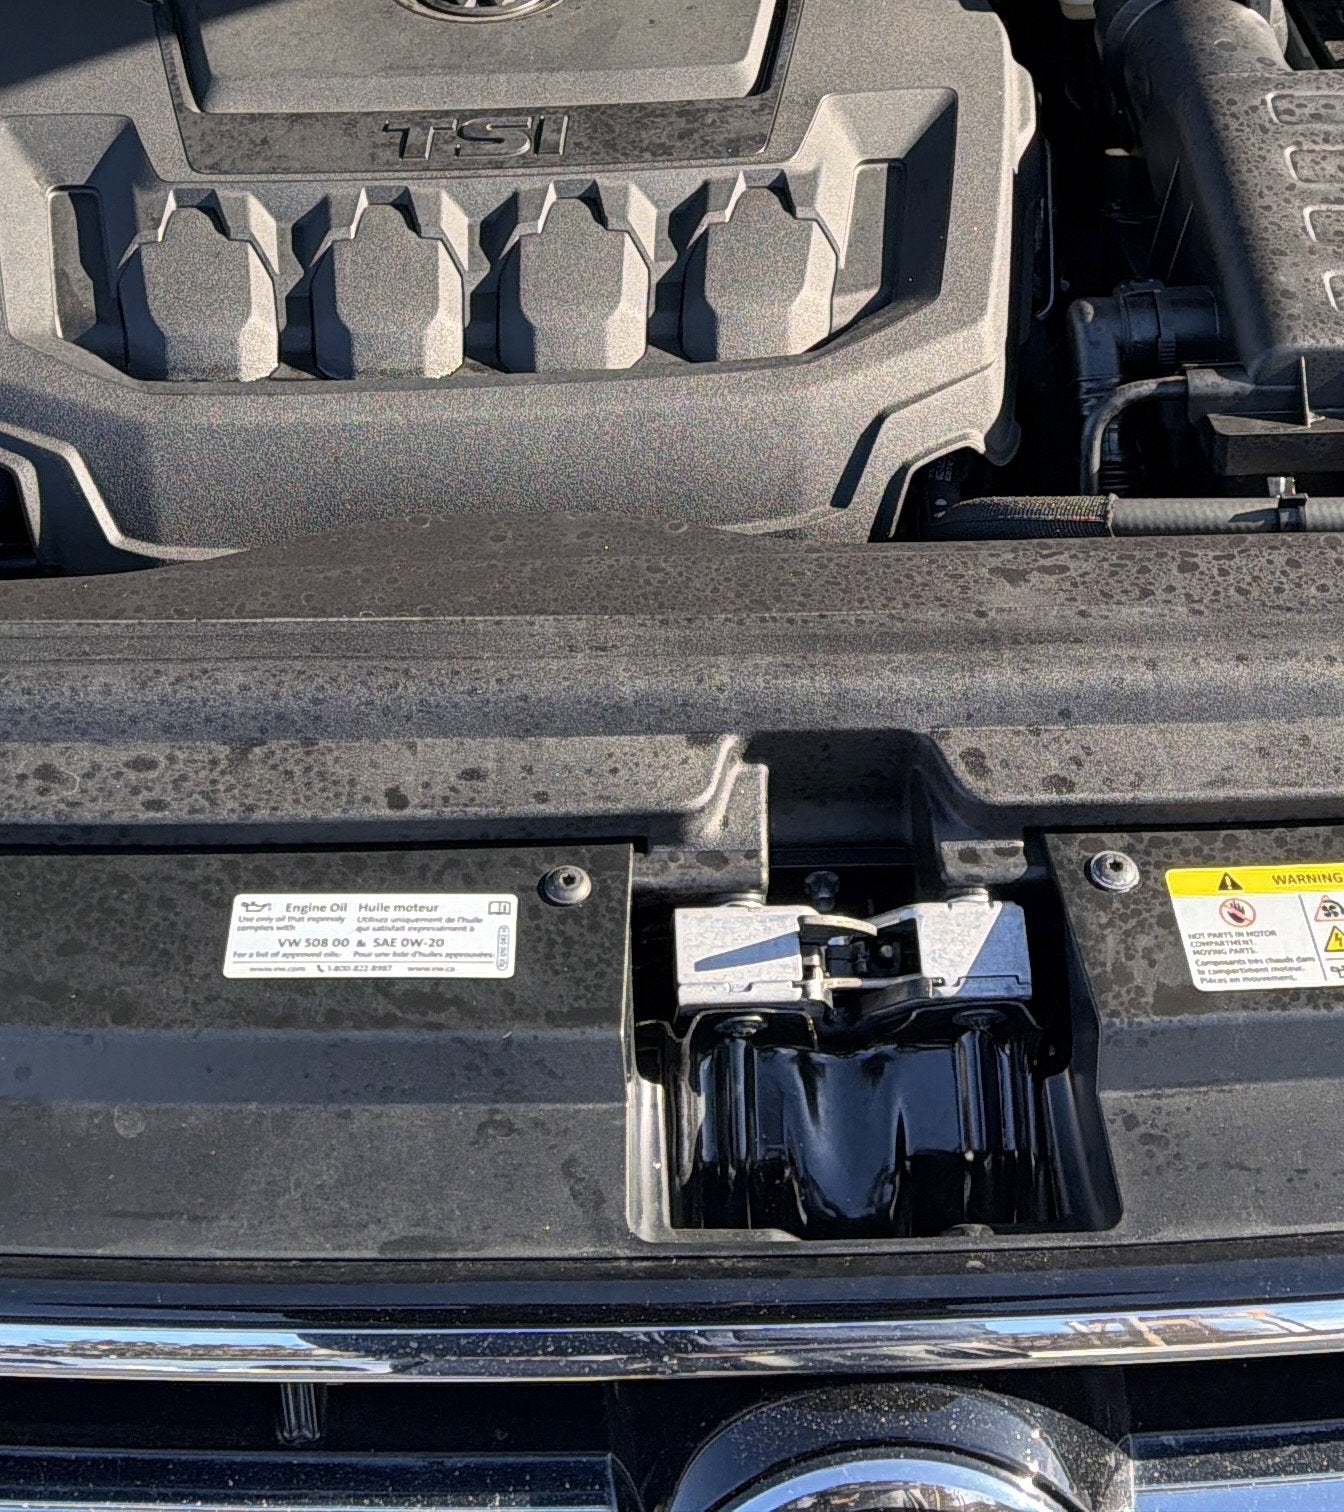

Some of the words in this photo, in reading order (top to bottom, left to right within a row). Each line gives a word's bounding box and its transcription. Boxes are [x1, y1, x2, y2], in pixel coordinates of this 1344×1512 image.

[381, 114, 570, 160] TSI
[1272, 872, 1344, 885] WARNING
[285, 903, 327, 914] Engine
[329, 903, 348, 912] Oil
[358, 903, 391, 912] Huile
[393, 904, 439, 912] moteur
[277, 938, 302, 947] VW
[304, 938, 329, 947] 508
[332, 938, 350, 947] 00
[373, 938, 398, 947] SAE
[400, 938, 445, 947] 0W-20
